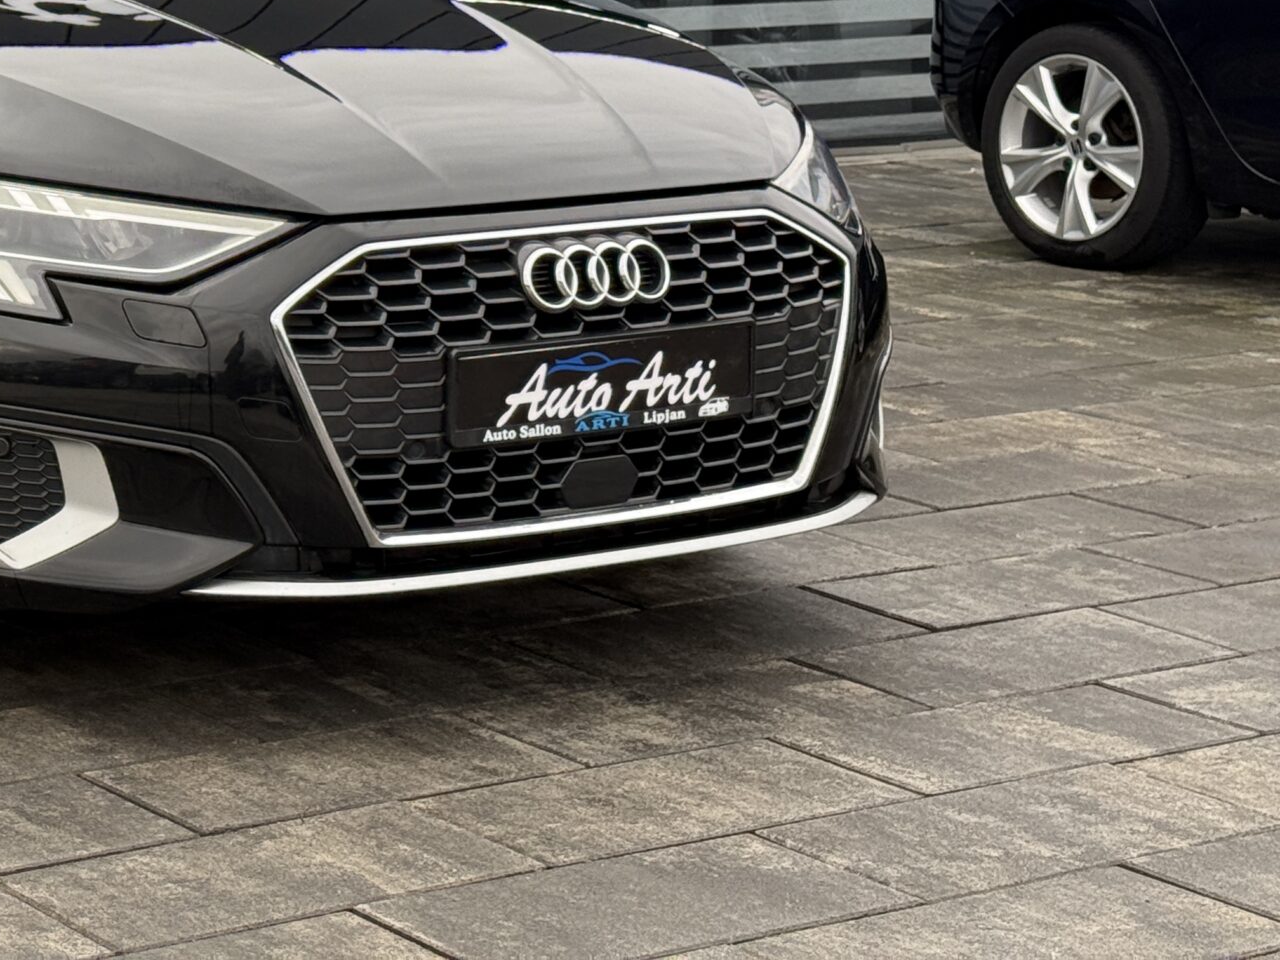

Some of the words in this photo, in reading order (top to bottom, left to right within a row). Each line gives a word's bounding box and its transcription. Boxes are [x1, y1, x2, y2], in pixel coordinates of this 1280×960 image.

[496, 363, 613, 427] Auto
[619, 350, 717, 413] Arti
[575, 414, 630, 432] ARTI
[643, 409, 686, 428] Lipjan
[483, 429, 517, 443] Auto
[519, 423, 562, 439] Sallon
